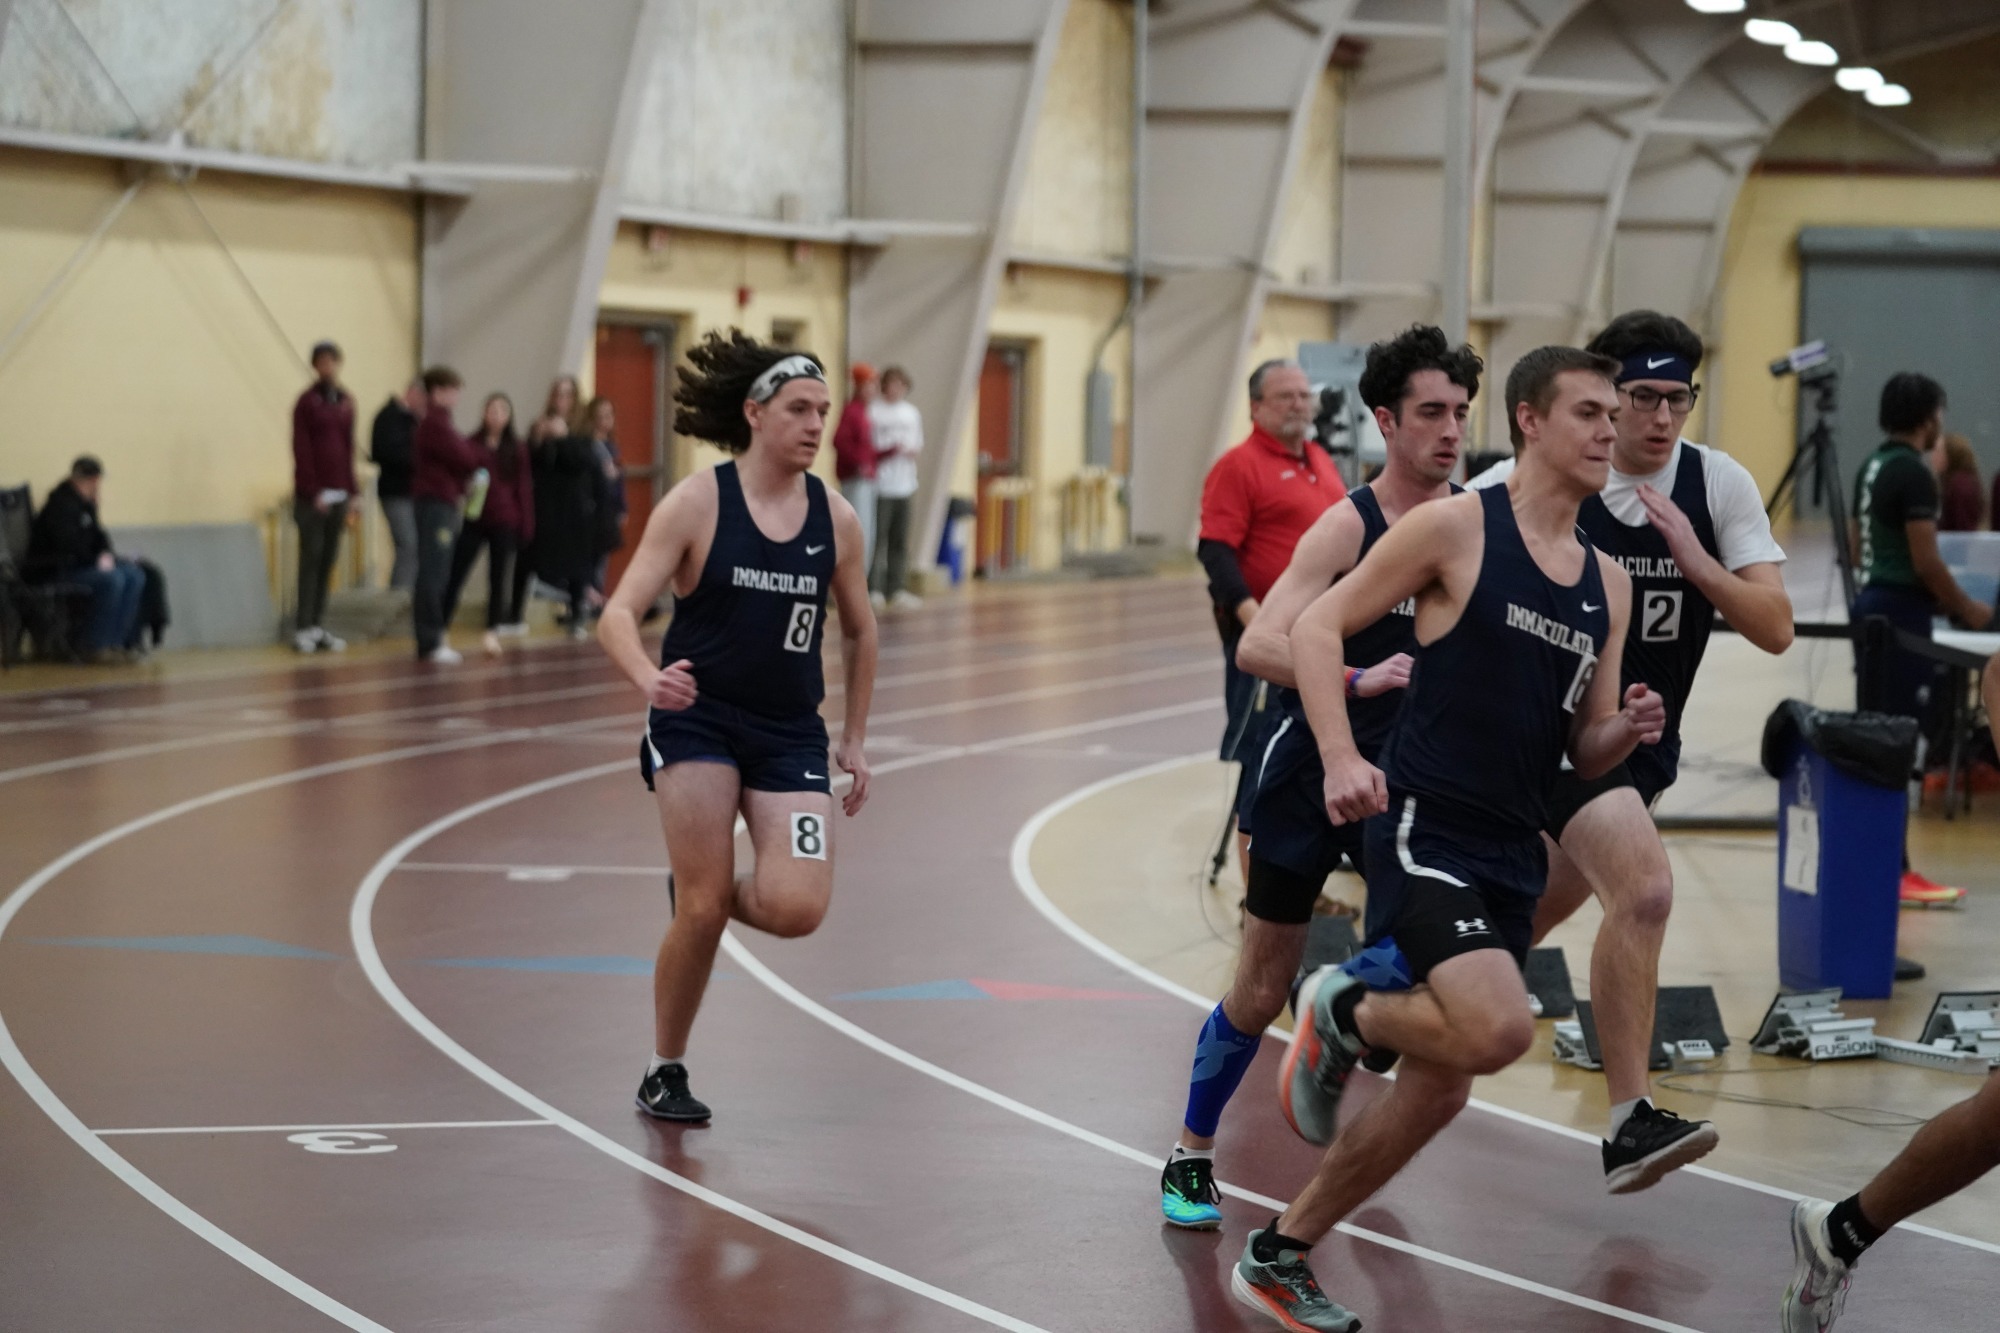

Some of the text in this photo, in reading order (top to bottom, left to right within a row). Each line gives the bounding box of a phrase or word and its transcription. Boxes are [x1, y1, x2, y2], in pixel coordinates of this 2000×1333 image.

[791, 607, 814, 648] 8
[1646, 594, 1676, 638] 2
[797, 815, 821, 855] 8
[1815, 1040, 1874, 1057] FUSION
[286, 1131, 399, 1154] 3
